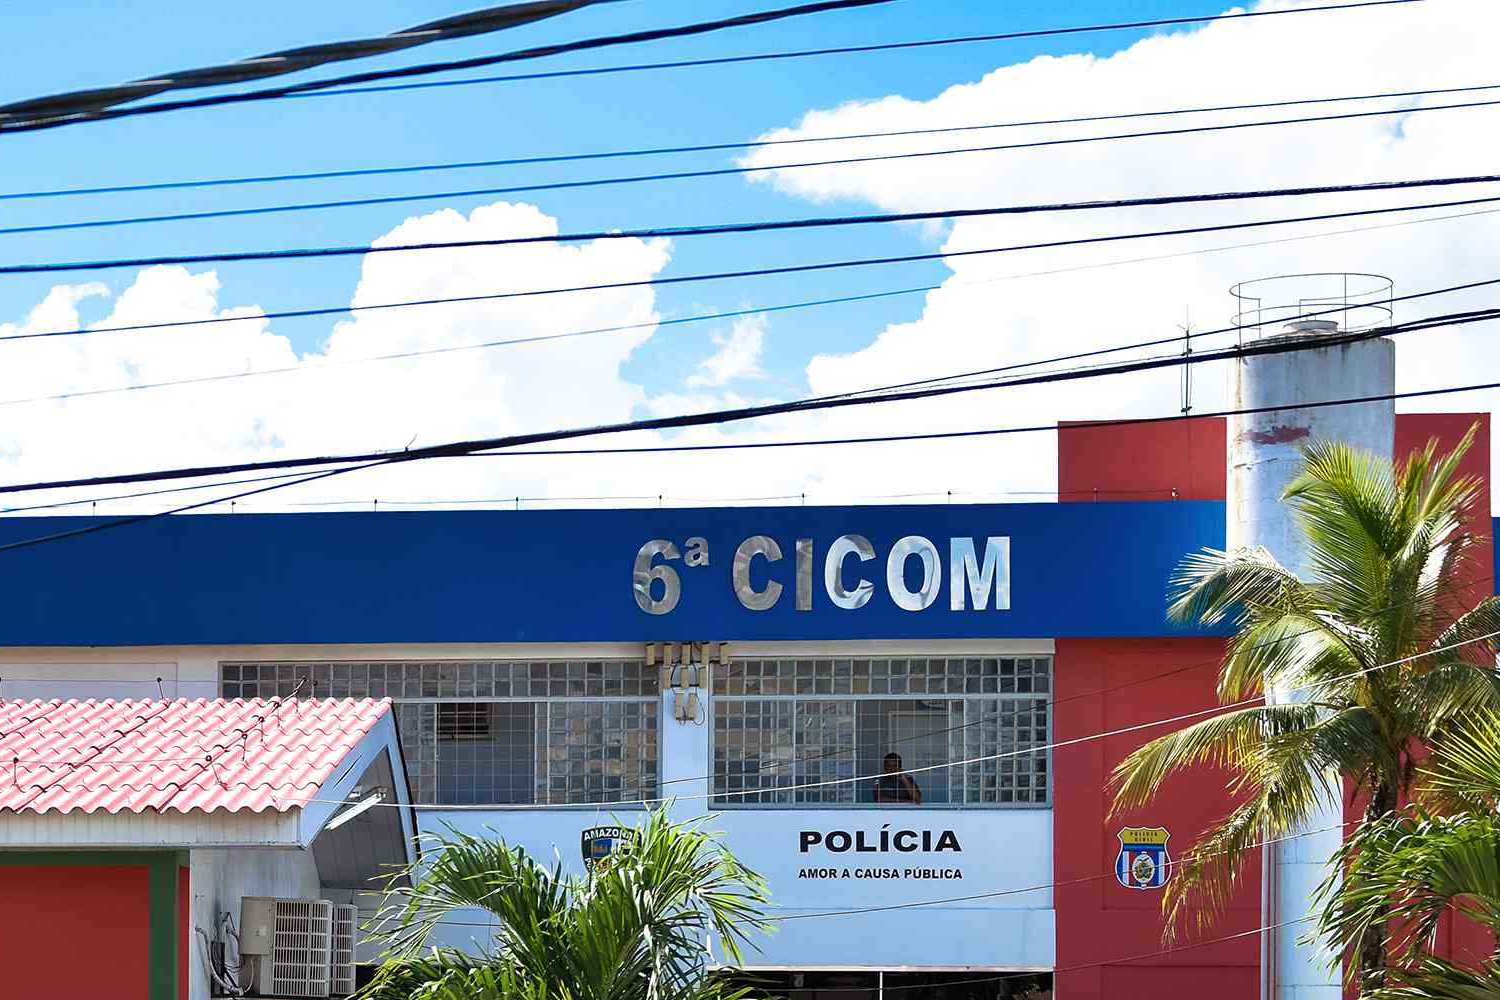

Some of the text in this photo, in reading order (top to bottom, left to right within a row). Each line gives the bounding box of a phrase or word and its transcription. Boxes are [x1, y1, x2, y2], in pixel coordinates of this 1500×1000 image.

[633, 534, 1011, 615] 6ª CICOM
[799, 823, 963, 853] POLÍCIA
[798, 866, 963, 879] AMOR A CAUSA PÚBLICA
